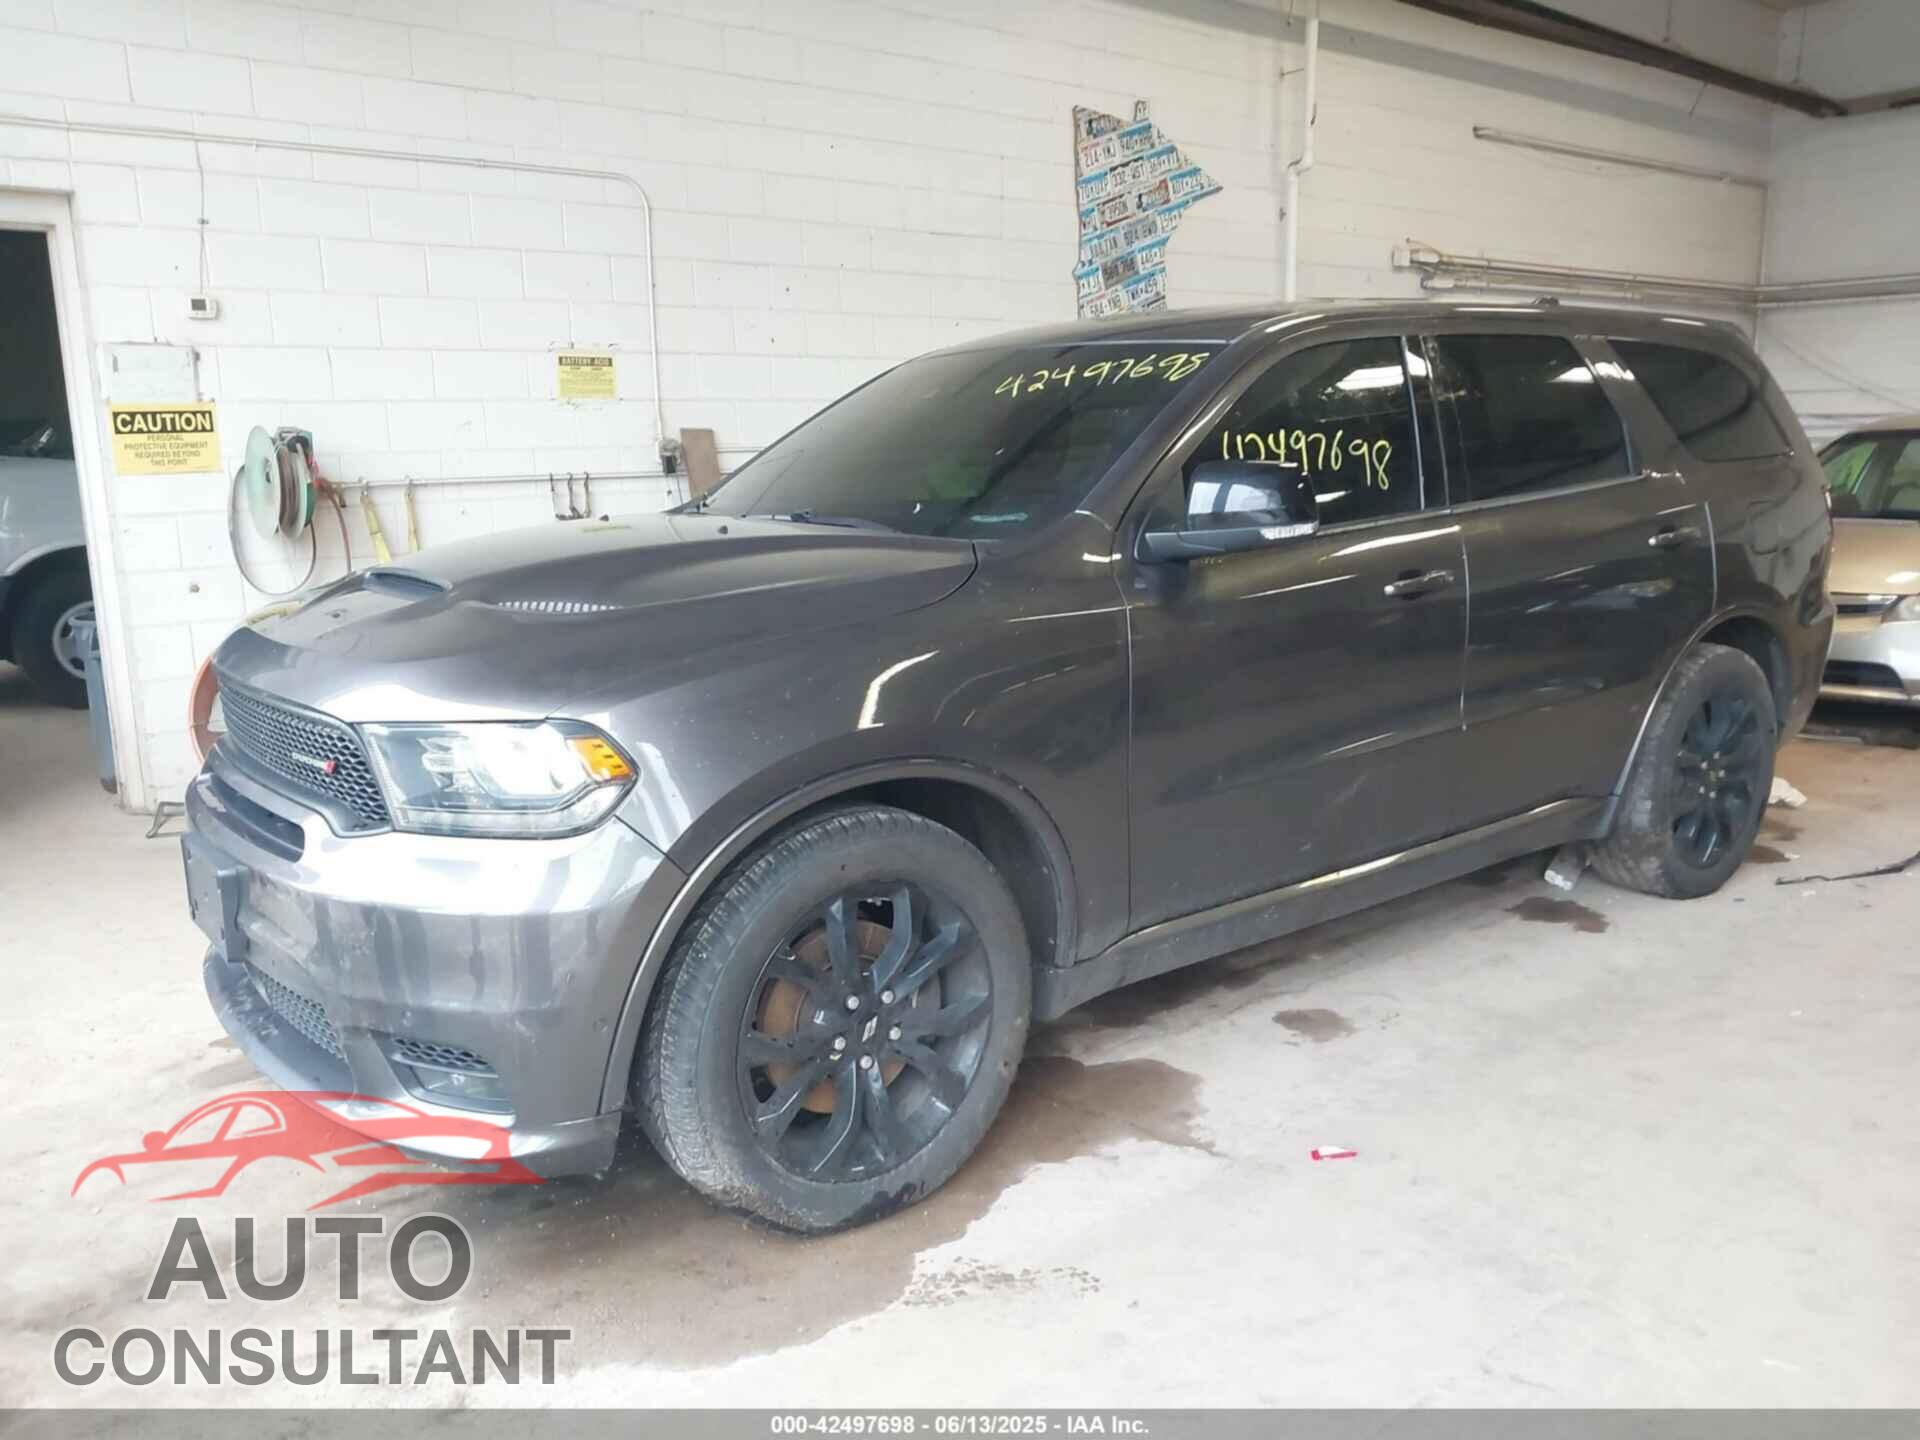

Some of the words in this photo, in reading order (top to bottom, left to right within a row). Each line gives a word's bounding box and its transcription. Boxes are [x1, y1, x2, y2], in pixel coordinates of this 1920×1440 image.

[994, 352, 1210, 398] 42497698
[116, 413, 211, 432] CAUTION
[124, 442, 167, 450] PROTECTIVE
[169, 441, 208, 449] EQUIPMENT
[172, 450, 200, 458] BEYOND
[167, 458, 187, 466] POINT
